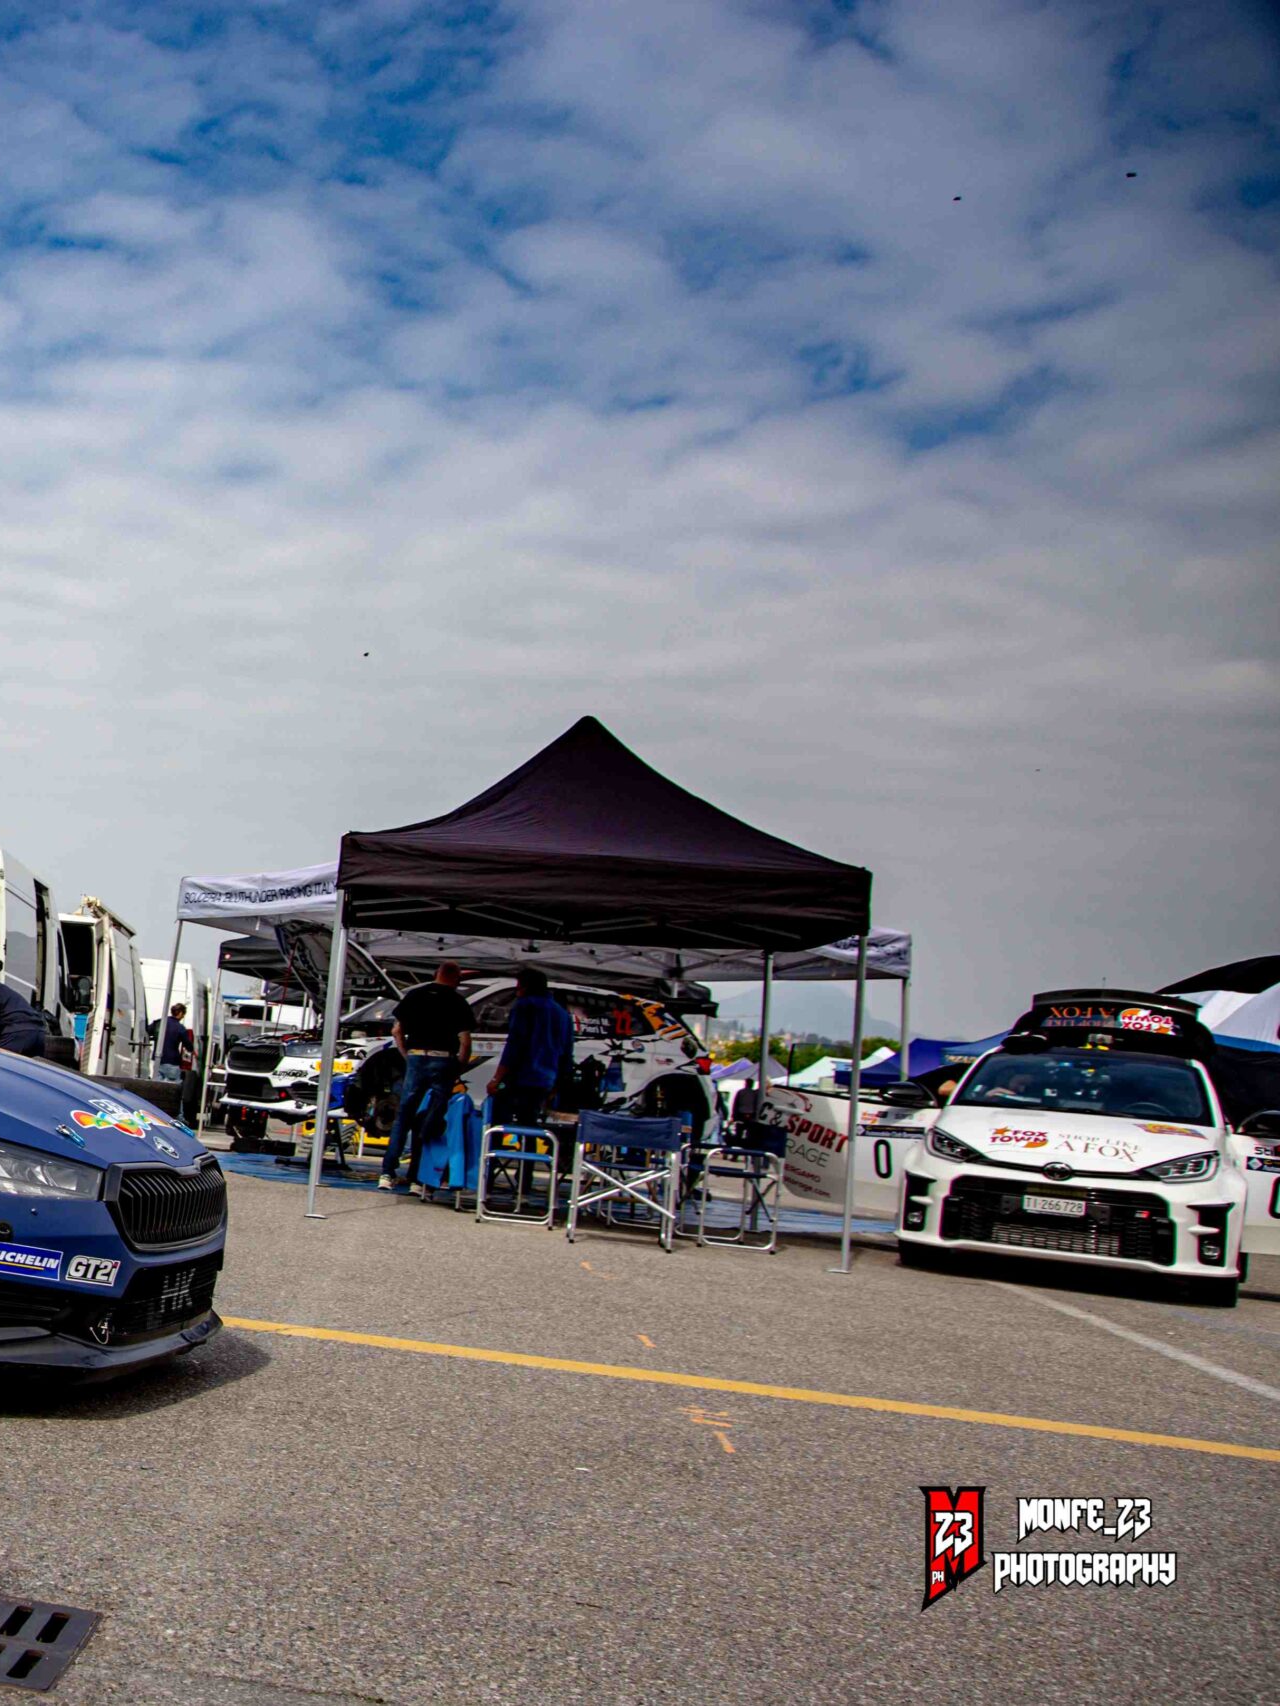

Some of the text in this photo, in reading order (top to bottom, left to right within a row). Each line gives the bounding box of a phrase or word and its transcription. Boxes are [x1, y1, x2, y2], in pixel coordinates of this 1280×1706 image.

[785, 1114, 849, 1153] SPORT
[1012, 1129, 1048, 1138] FOX
[786, 1138, 831, 1168] RAGE
[873, 1138, 893, 1180] 0
[1083, 1142, 1135, 1162] FOX
[783, 1163, 822, 1183] ERGAMO
